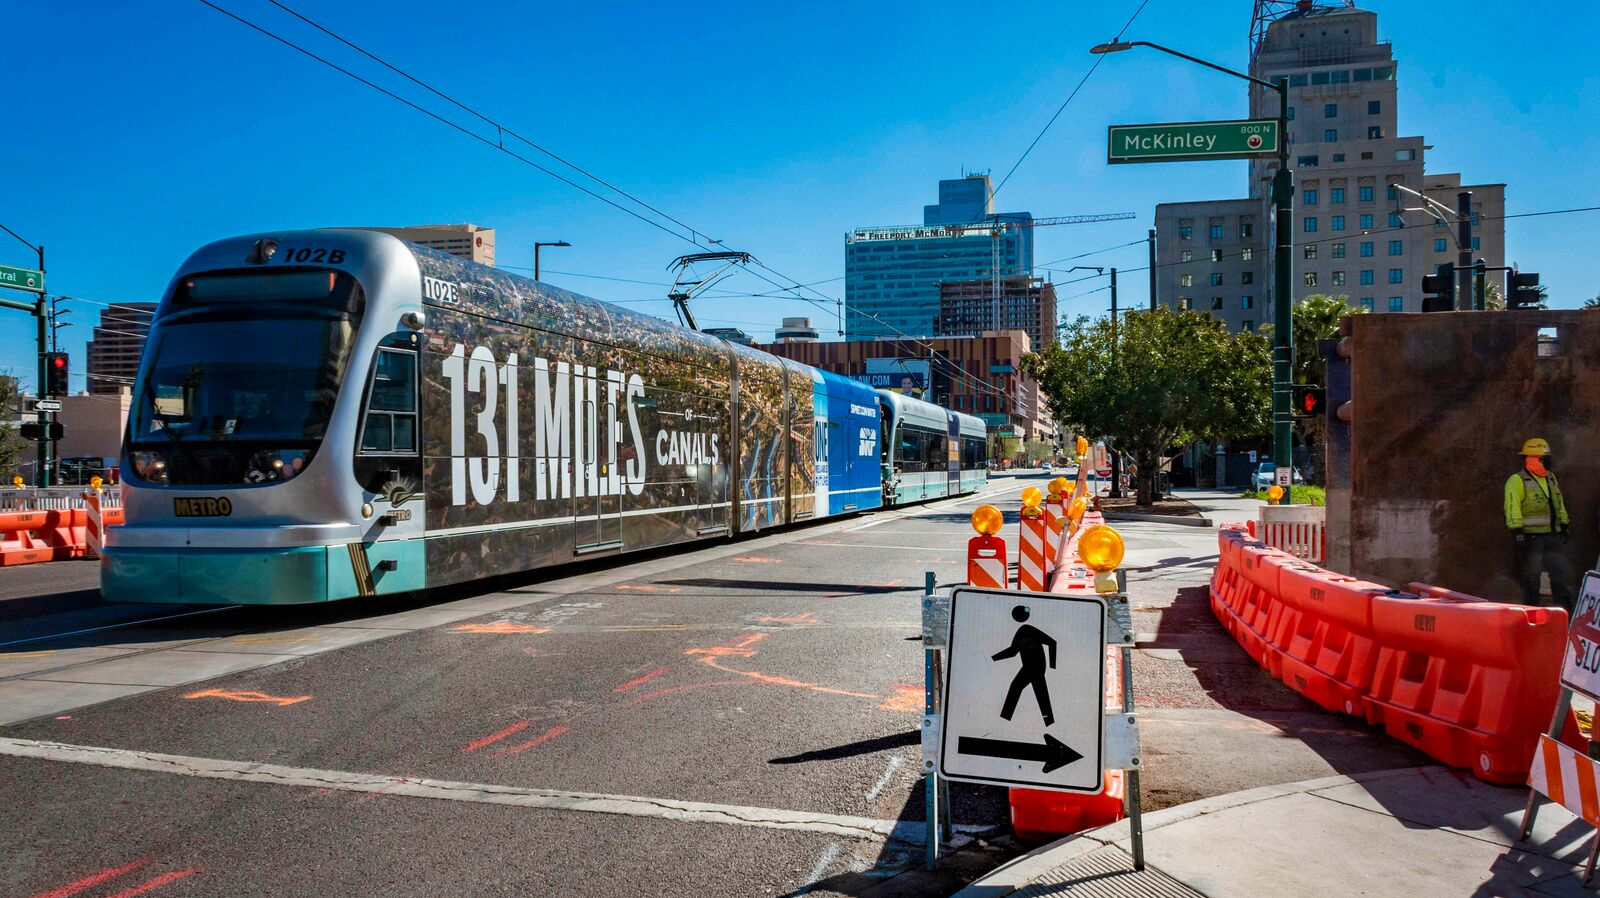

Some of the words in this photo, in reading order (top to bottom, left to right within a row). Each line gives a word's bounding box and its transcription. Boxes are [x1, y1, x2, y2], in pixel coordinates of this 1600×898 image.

[1240, 126, 1260, 134] 800
[1262, 125, 1270, 133] N
[1125, 133, 1216, 151] McKinley
[284, 248, 346, 264] 102B
[427, 279, 458, 303] 102B
[685, 408, 693, 421] OF
[442, 343, 519, 505] 131
[535, 357, 646, 500] MILES
[656, 429, 718, 465] CANALS
[175, 498, 231, 517] METRO
